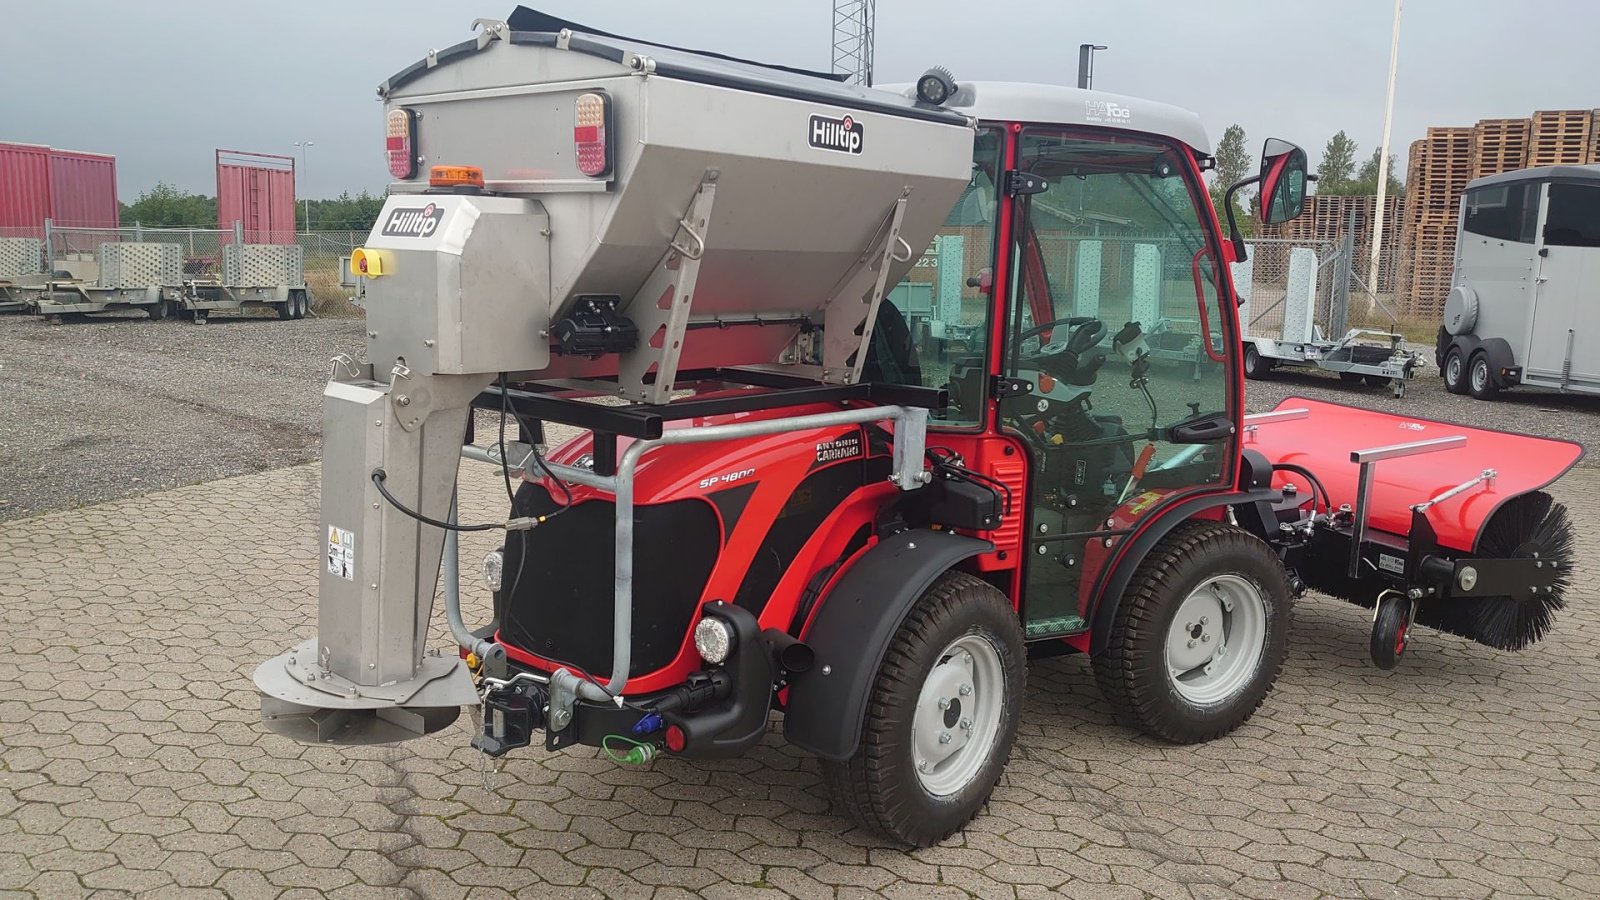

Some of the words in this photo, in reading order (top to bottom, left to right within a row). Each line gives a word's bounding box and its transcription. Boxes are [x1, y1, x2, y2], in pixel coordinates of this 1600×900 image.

[813, 120, 860, 154] Hilltip
[386, 212, 437, 238] Hilltip
[816, 438, 858, 451] ANTONIO
[816, 445, 859, 462] CARRARO
[699, 476, 719, 489] SP
[721, 468, 756, 483] 4800
